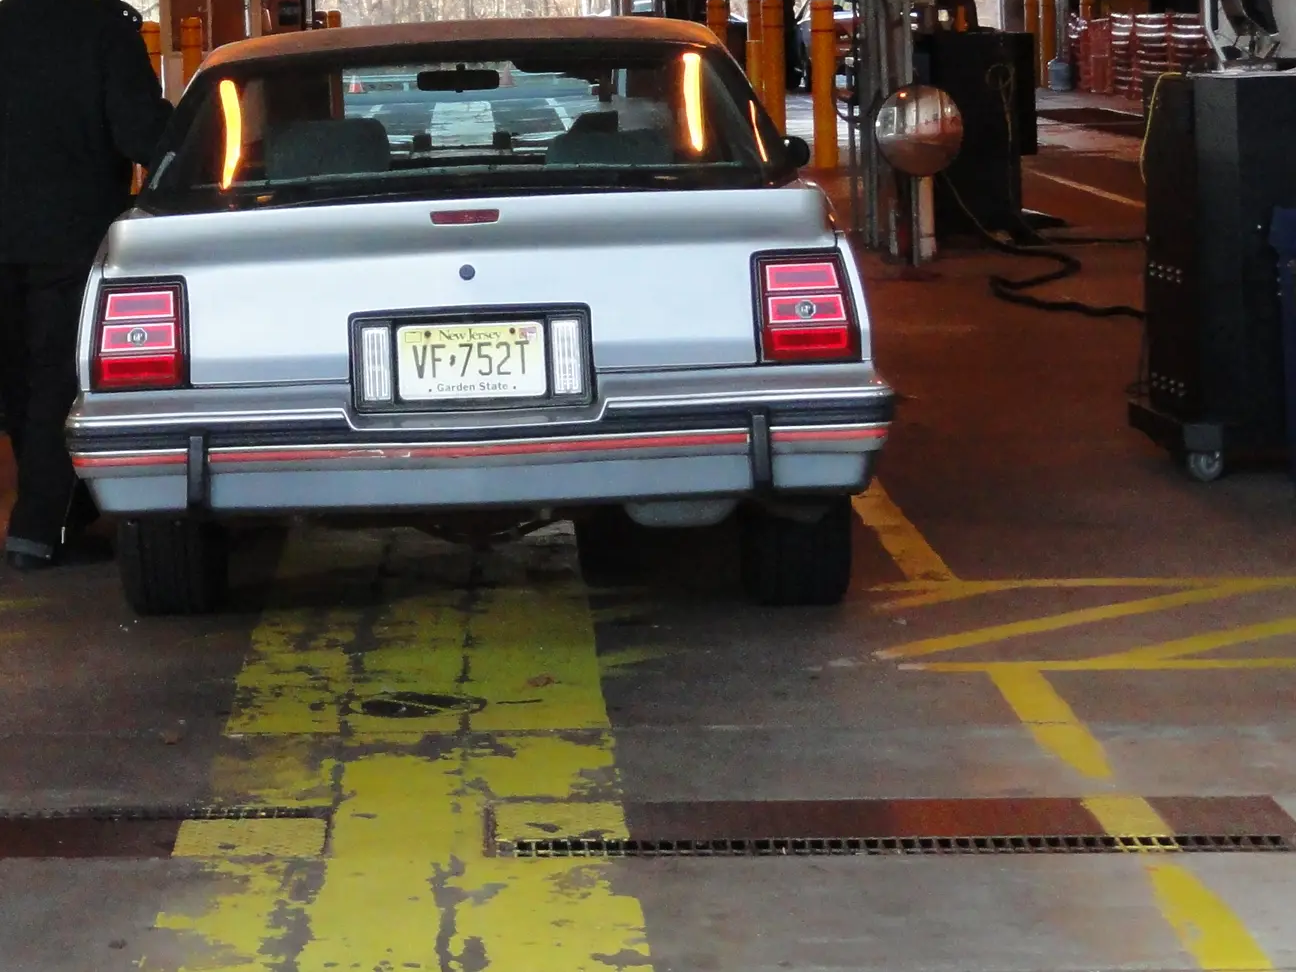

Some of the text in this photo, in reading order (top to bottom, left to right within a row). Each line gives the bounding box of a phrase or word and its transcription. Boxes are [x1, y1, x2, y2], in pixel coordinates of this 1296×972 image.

[438, 328, 501, 342] New Jersey
[437, 381, 508, 392] Garden State
